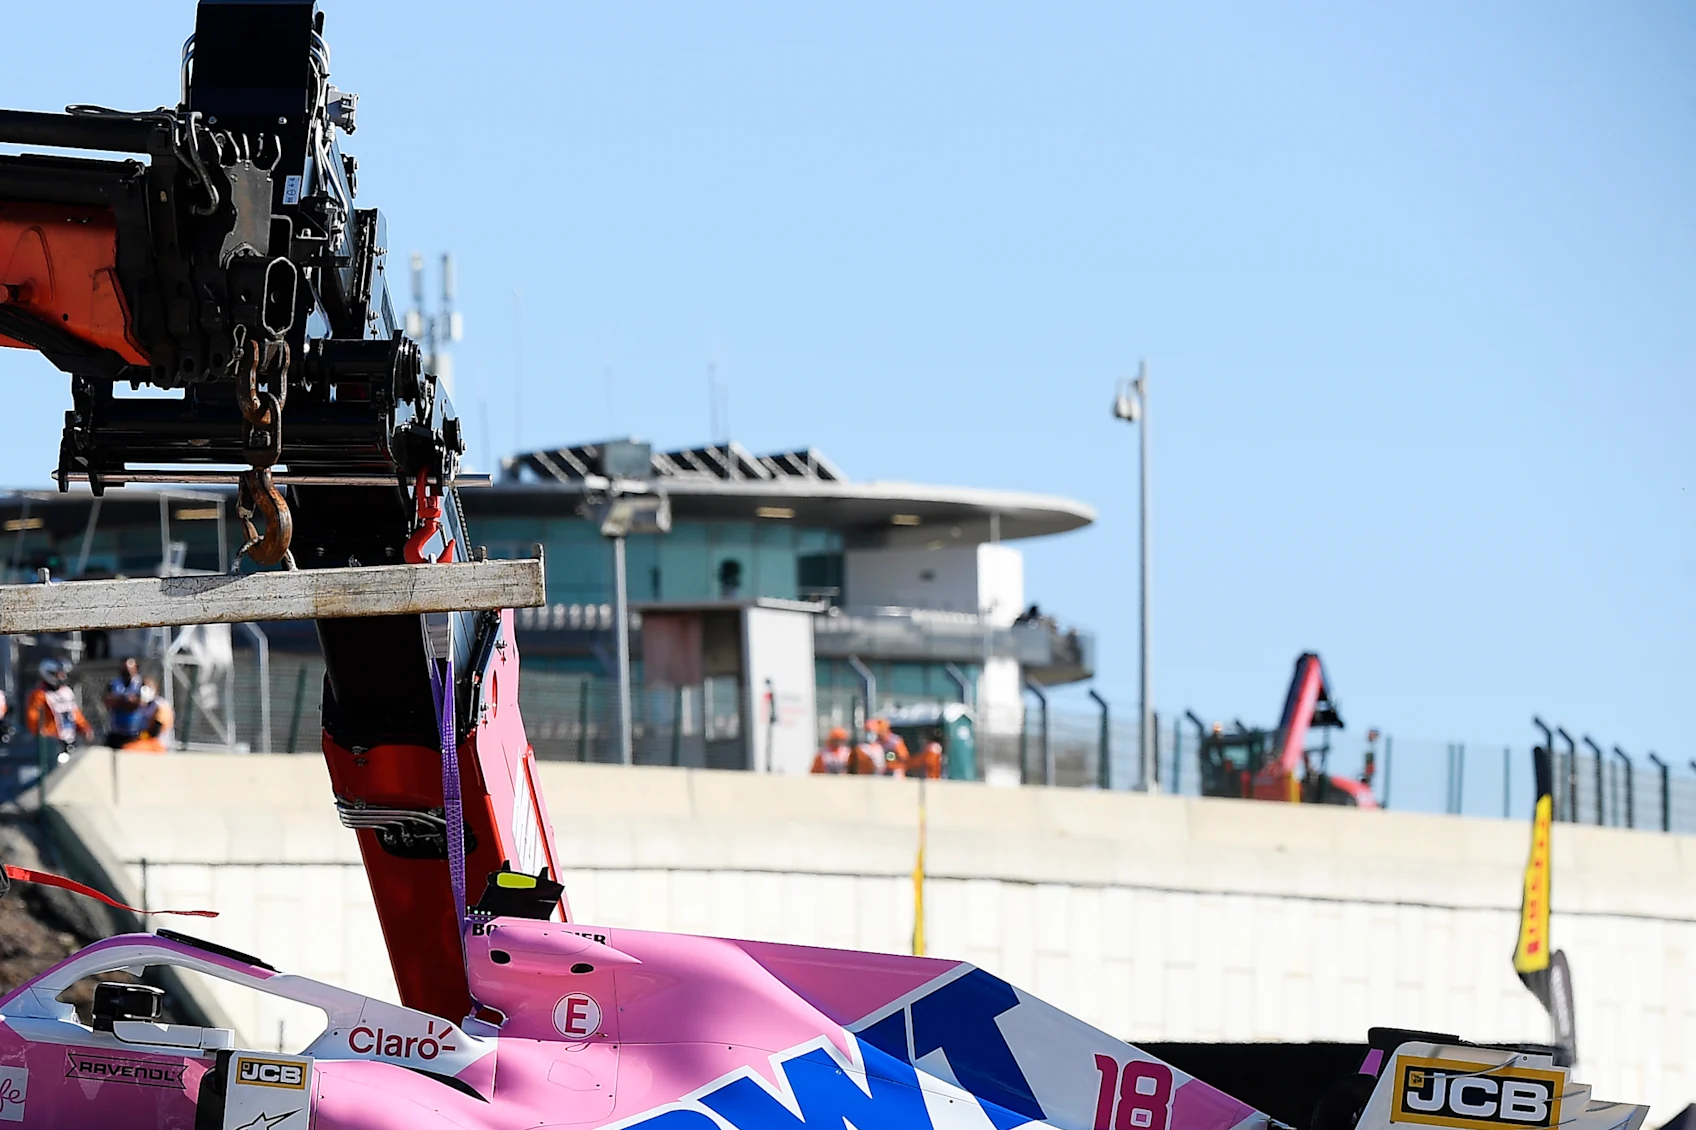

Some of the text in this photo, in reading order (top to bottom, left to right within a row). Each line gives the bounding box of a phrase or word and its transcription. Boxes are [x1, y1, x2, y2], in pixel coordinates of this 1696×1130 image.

[564, 998, 588, 1034] E
[349, 1026, 439, 1060] Claro
[79, 1061, 176, 1082] RAVENOL
[241, 1063, 302, 1085] JCB
[1406, 1072, 1549, 1122] JCB
